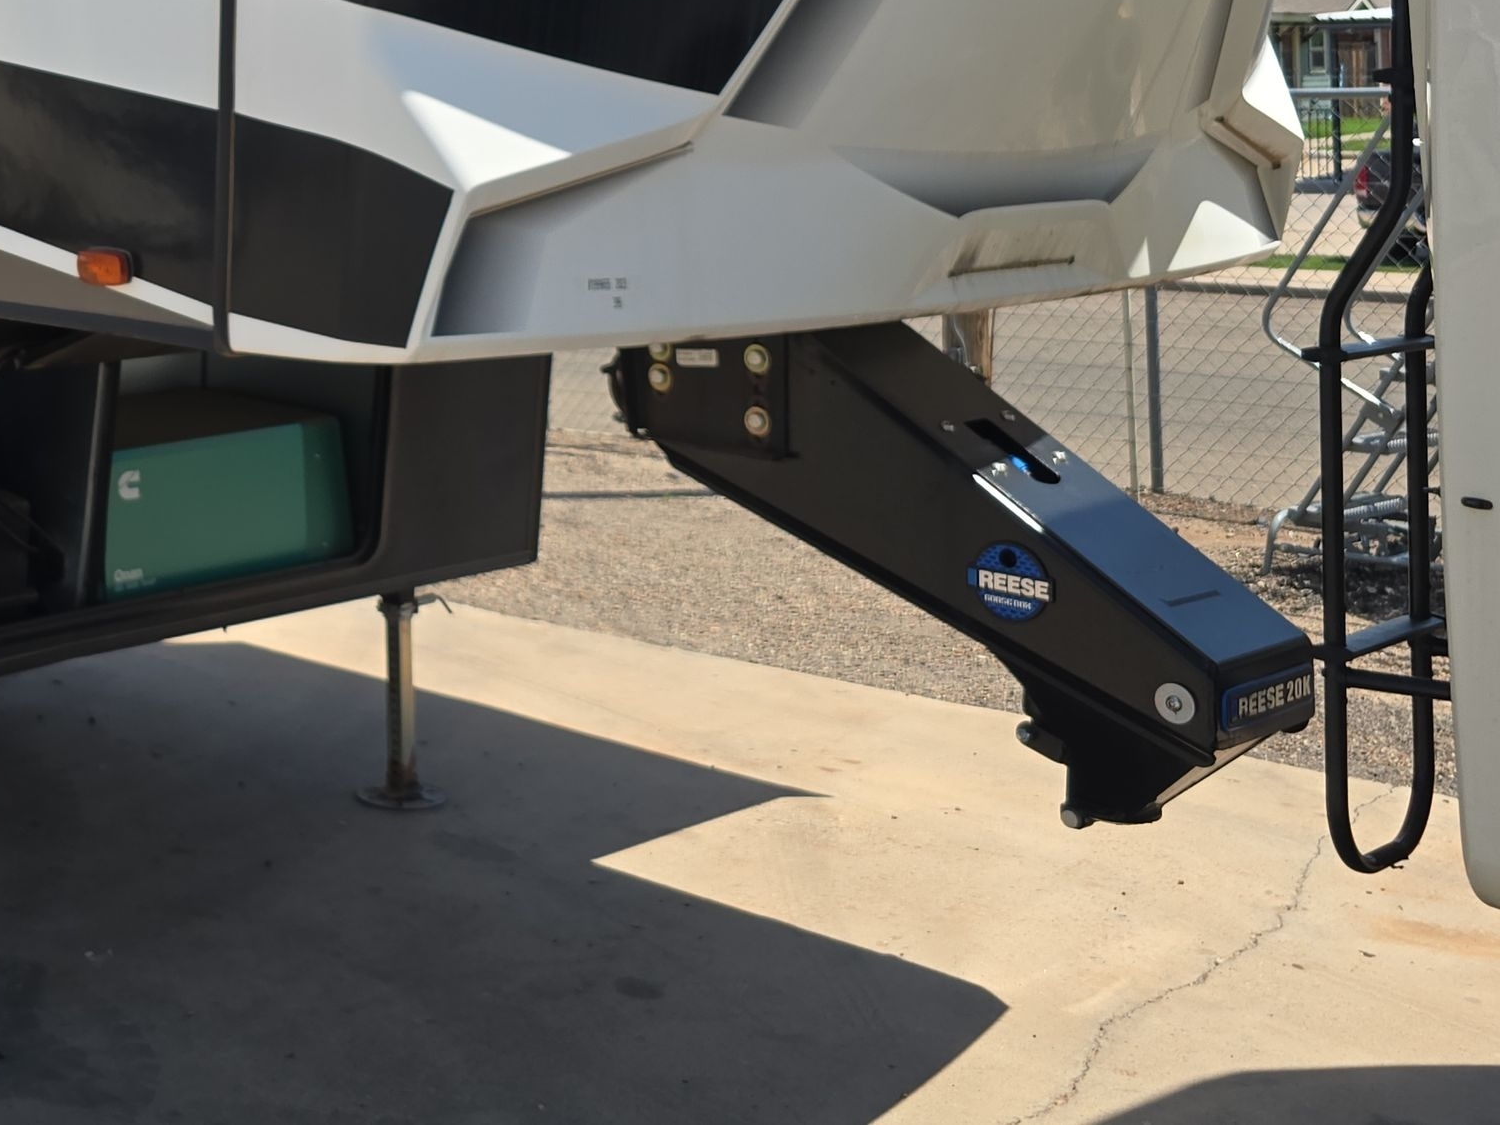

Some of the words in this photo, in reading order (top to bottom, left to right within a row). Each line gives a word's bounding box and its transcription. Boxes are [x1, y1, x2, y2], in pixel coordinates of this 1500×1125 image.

[978, 569, 1049, 602] REESE
[1238, 683, 1285, 719] REESE
[1286, 674, 1311, 703] 20K
